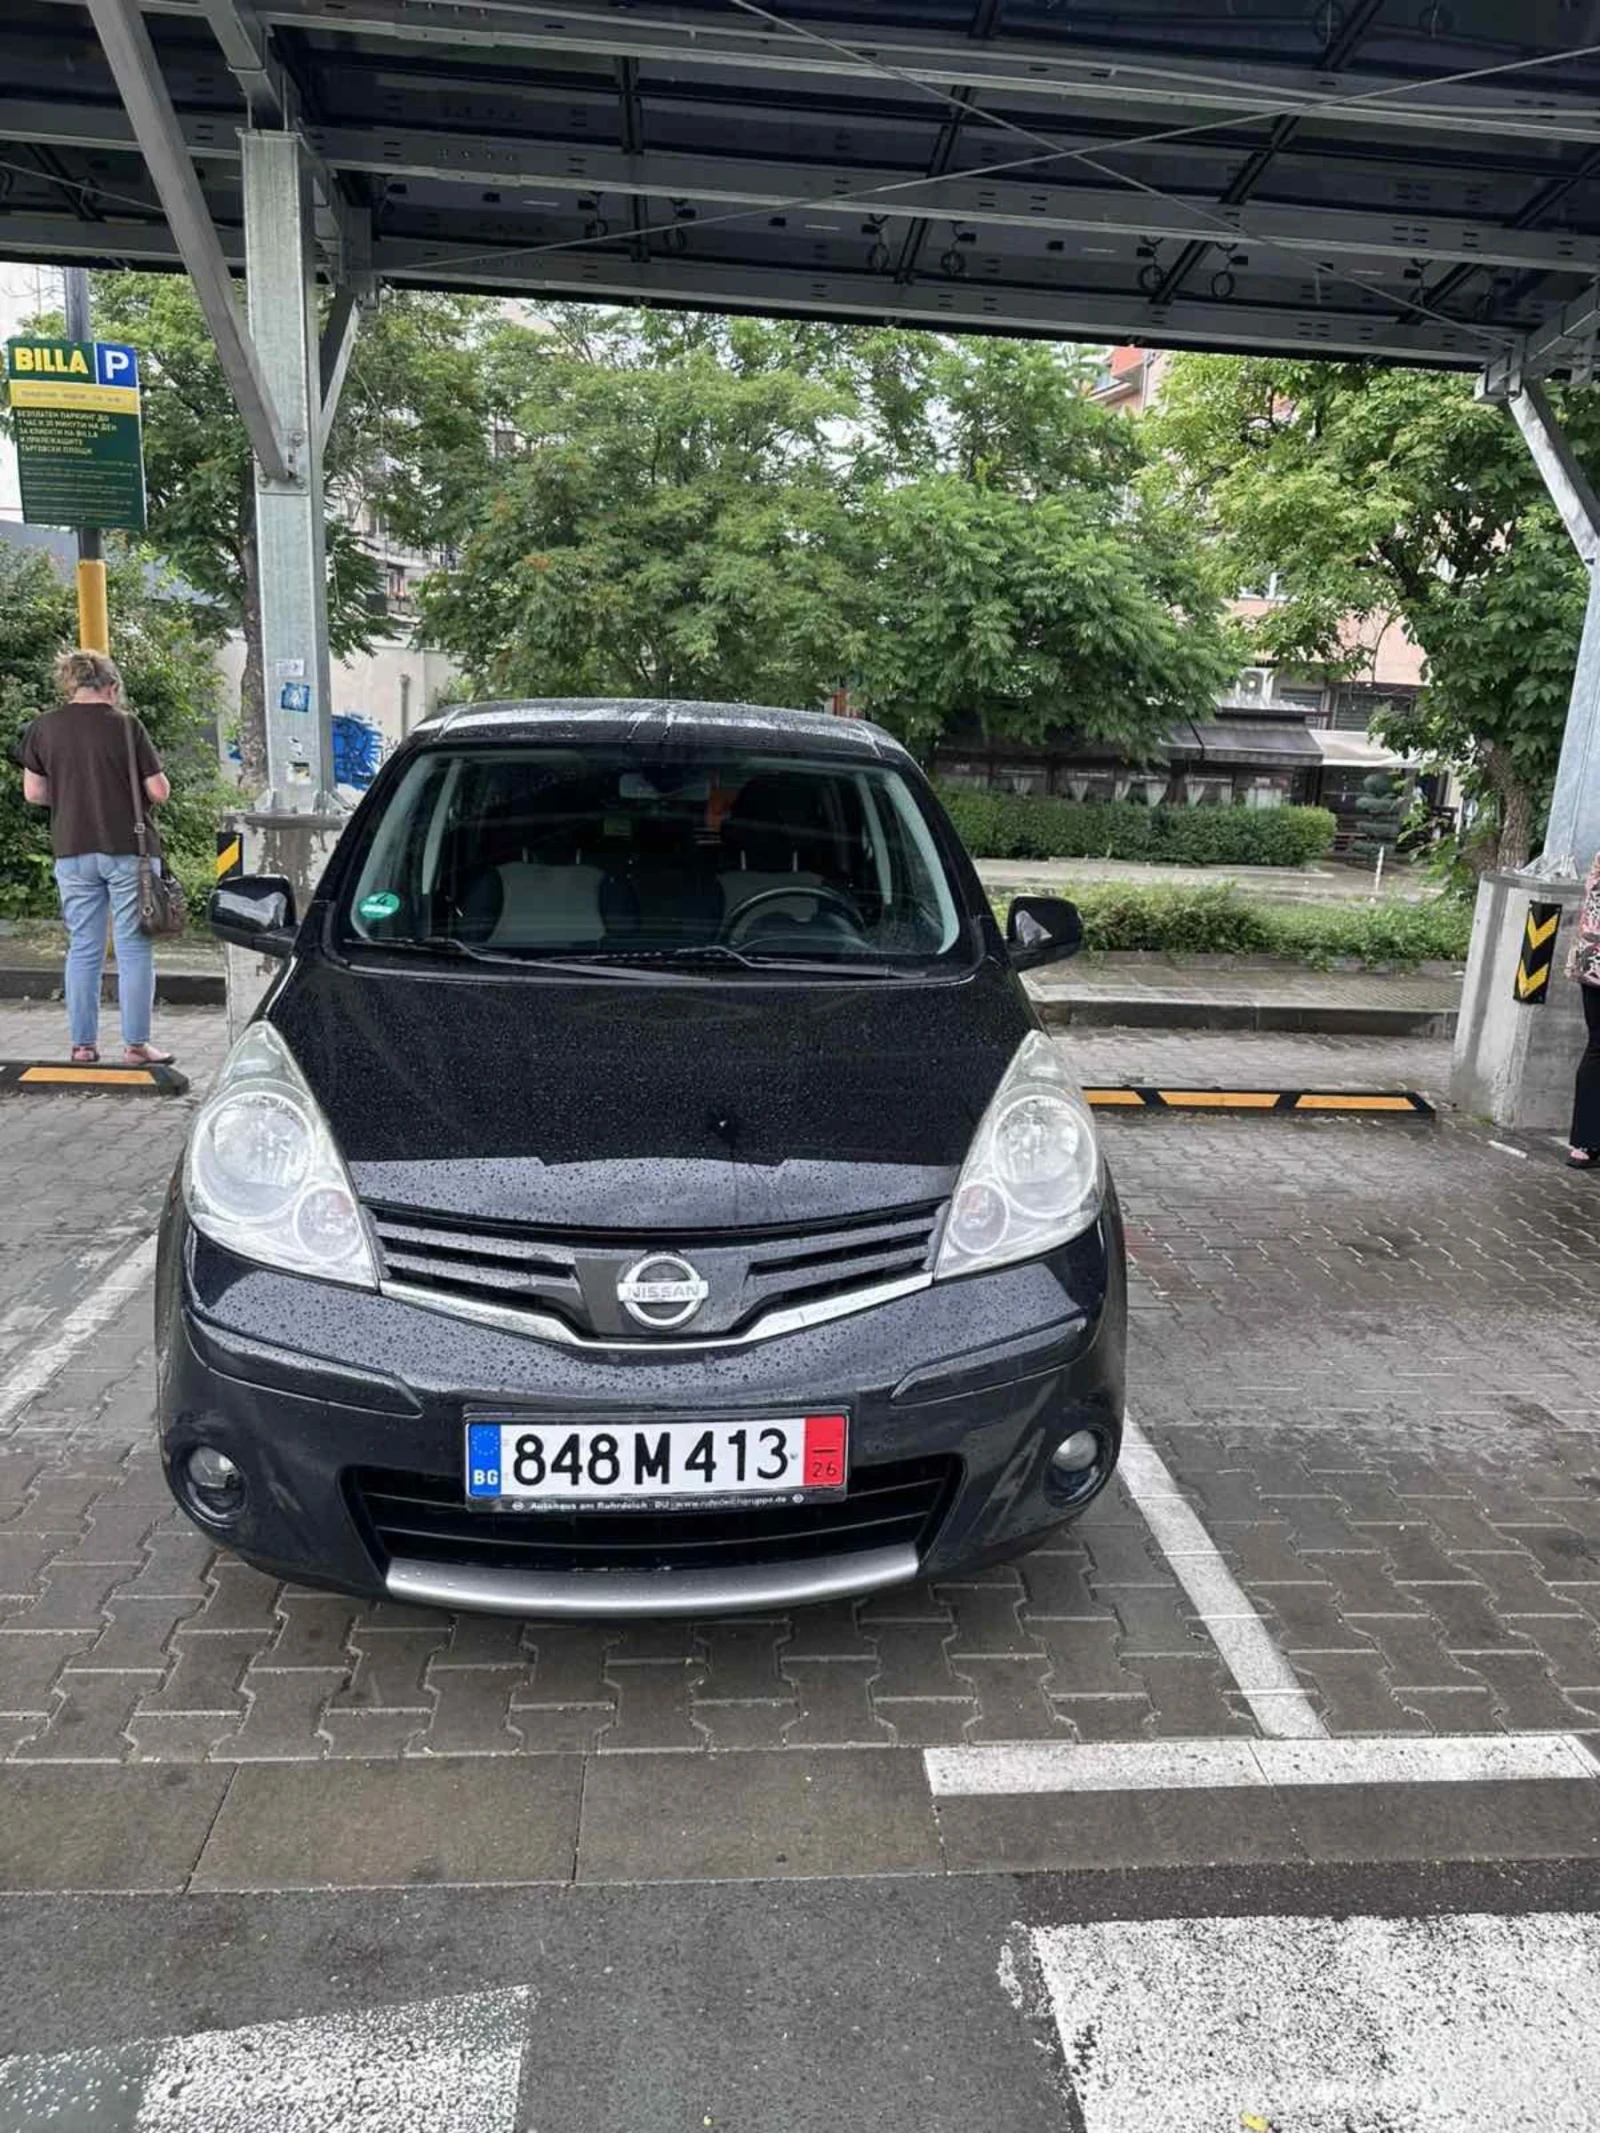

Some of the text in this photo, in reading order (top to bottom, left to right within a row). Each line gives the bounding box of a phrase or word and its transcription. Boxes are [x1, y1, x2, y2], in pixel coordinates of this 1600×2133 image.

[15, 347, 129, 379] BILLA P
[60, 411, 96, 420] ПАРКИНГ
[88, 422, 99, 430] НА
[626, 1284, 700, 1299] NISSAN
[513, 1428, 788, 1486] 848 M 413
[473, 1469, 499, 1485] BG
[812, 1461, 837, 1478] 26
[530, 1501, 577, 1510] Autohaus
